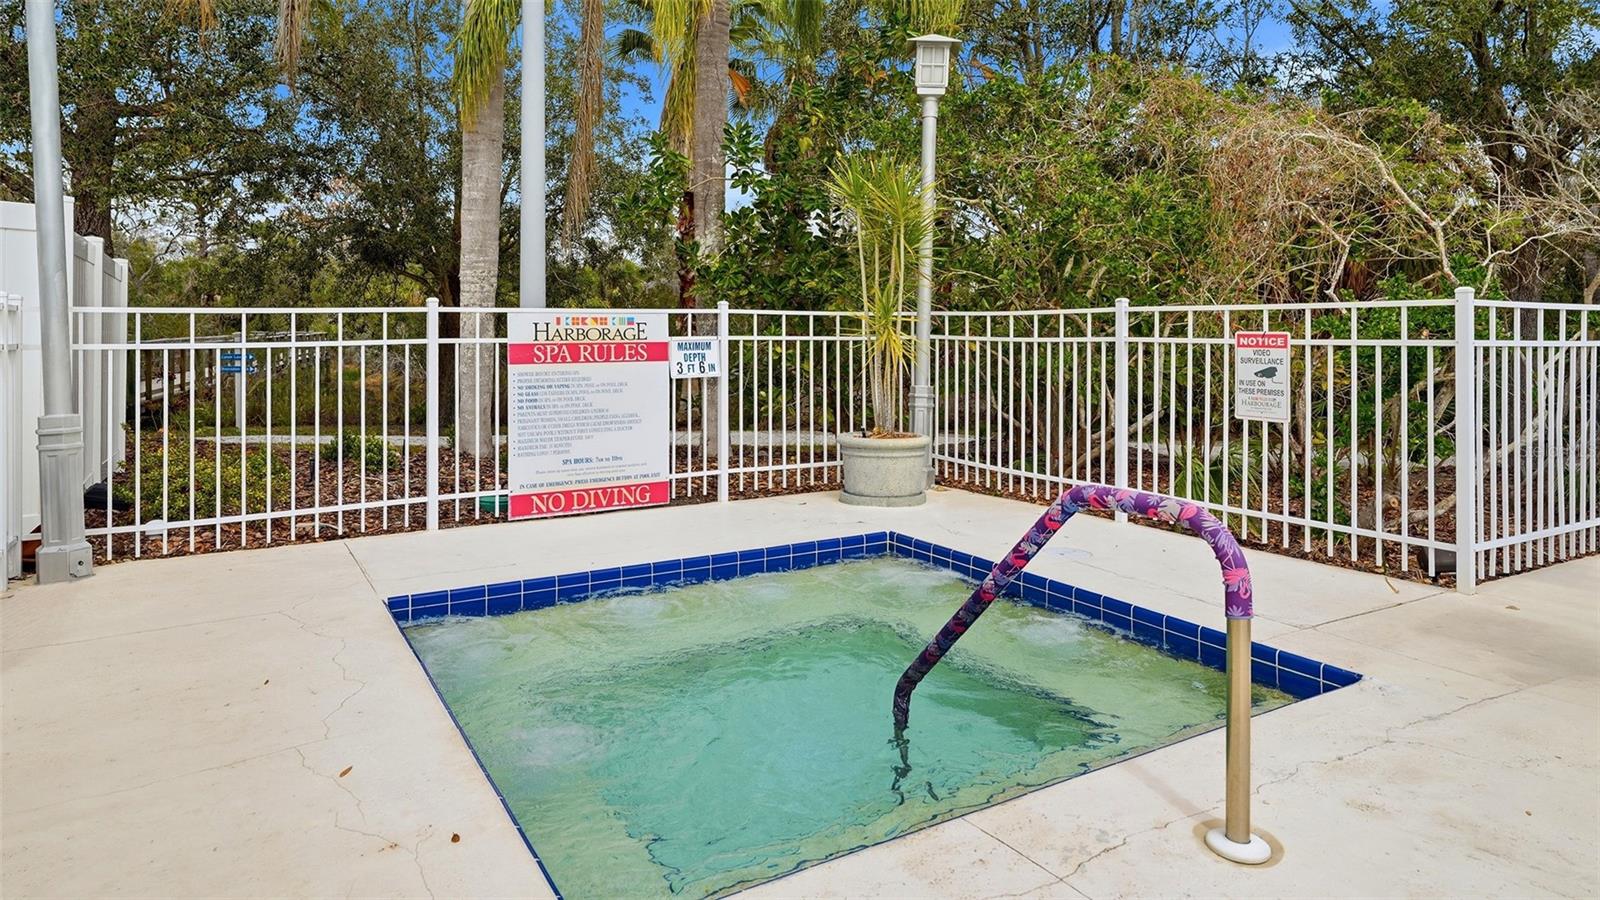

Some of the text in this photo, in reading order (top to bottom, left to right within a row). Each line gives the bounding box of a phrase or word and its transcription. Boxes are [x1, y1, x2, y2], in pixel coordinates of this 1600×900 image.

[532, 322, 648, 342] HARBORAGE
[677, 341, 712, 351] MAXIMUM
[1240, 337, 1285, 346] NOTICE
[533, 343, 648, 364] SPA RULES
[683, 352, 706, 362] DEPTH
[1240, 357, 1284, 366] SURVEILLANCE
[676, 360, 716, 374] 3 FT 6 IN
[1238, 387, 1285, 396] THESE PREMISES
[531, 485, 650, 514] NO DIVING
